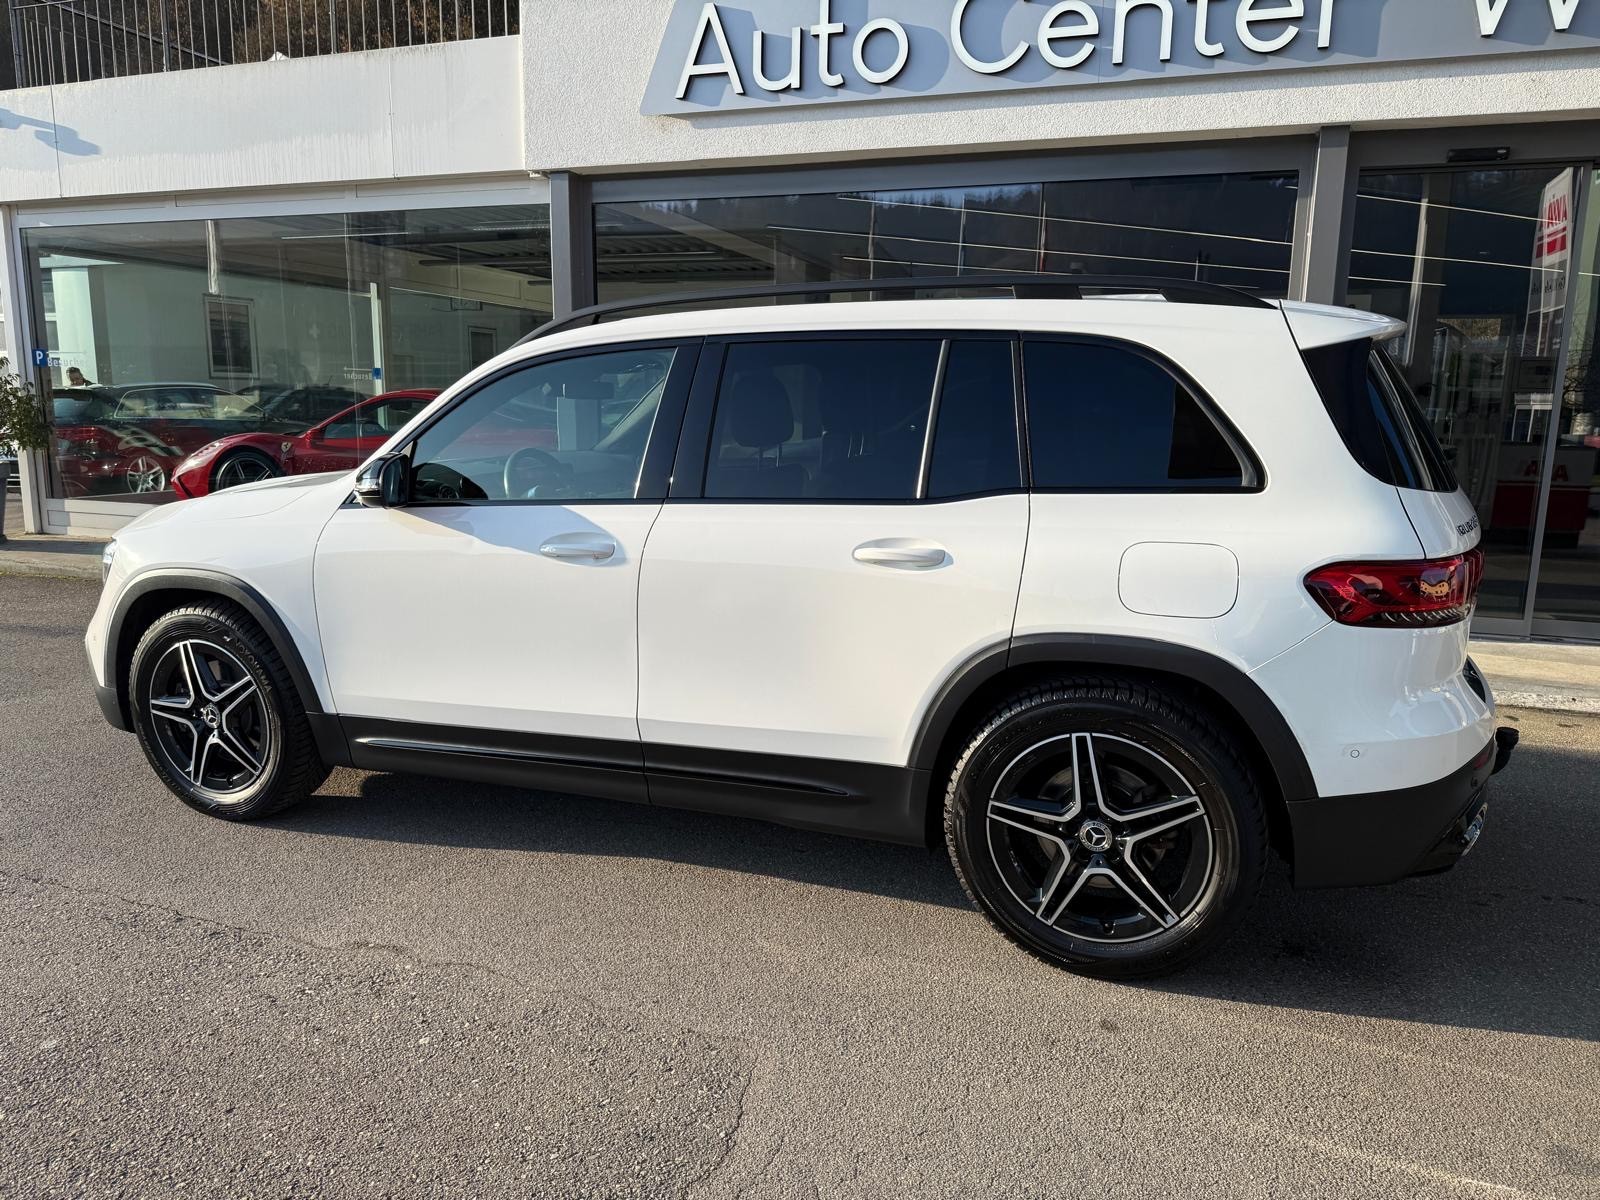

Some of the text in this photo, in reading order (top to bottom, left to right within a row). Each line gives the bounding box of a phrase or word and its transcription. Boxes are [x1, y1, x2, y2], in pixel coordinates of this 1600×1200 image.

[674, 0, 909, 100] Auto
[35, 350, 44, 365] P
[235, 640, 272, 692] YOKOHAMA
